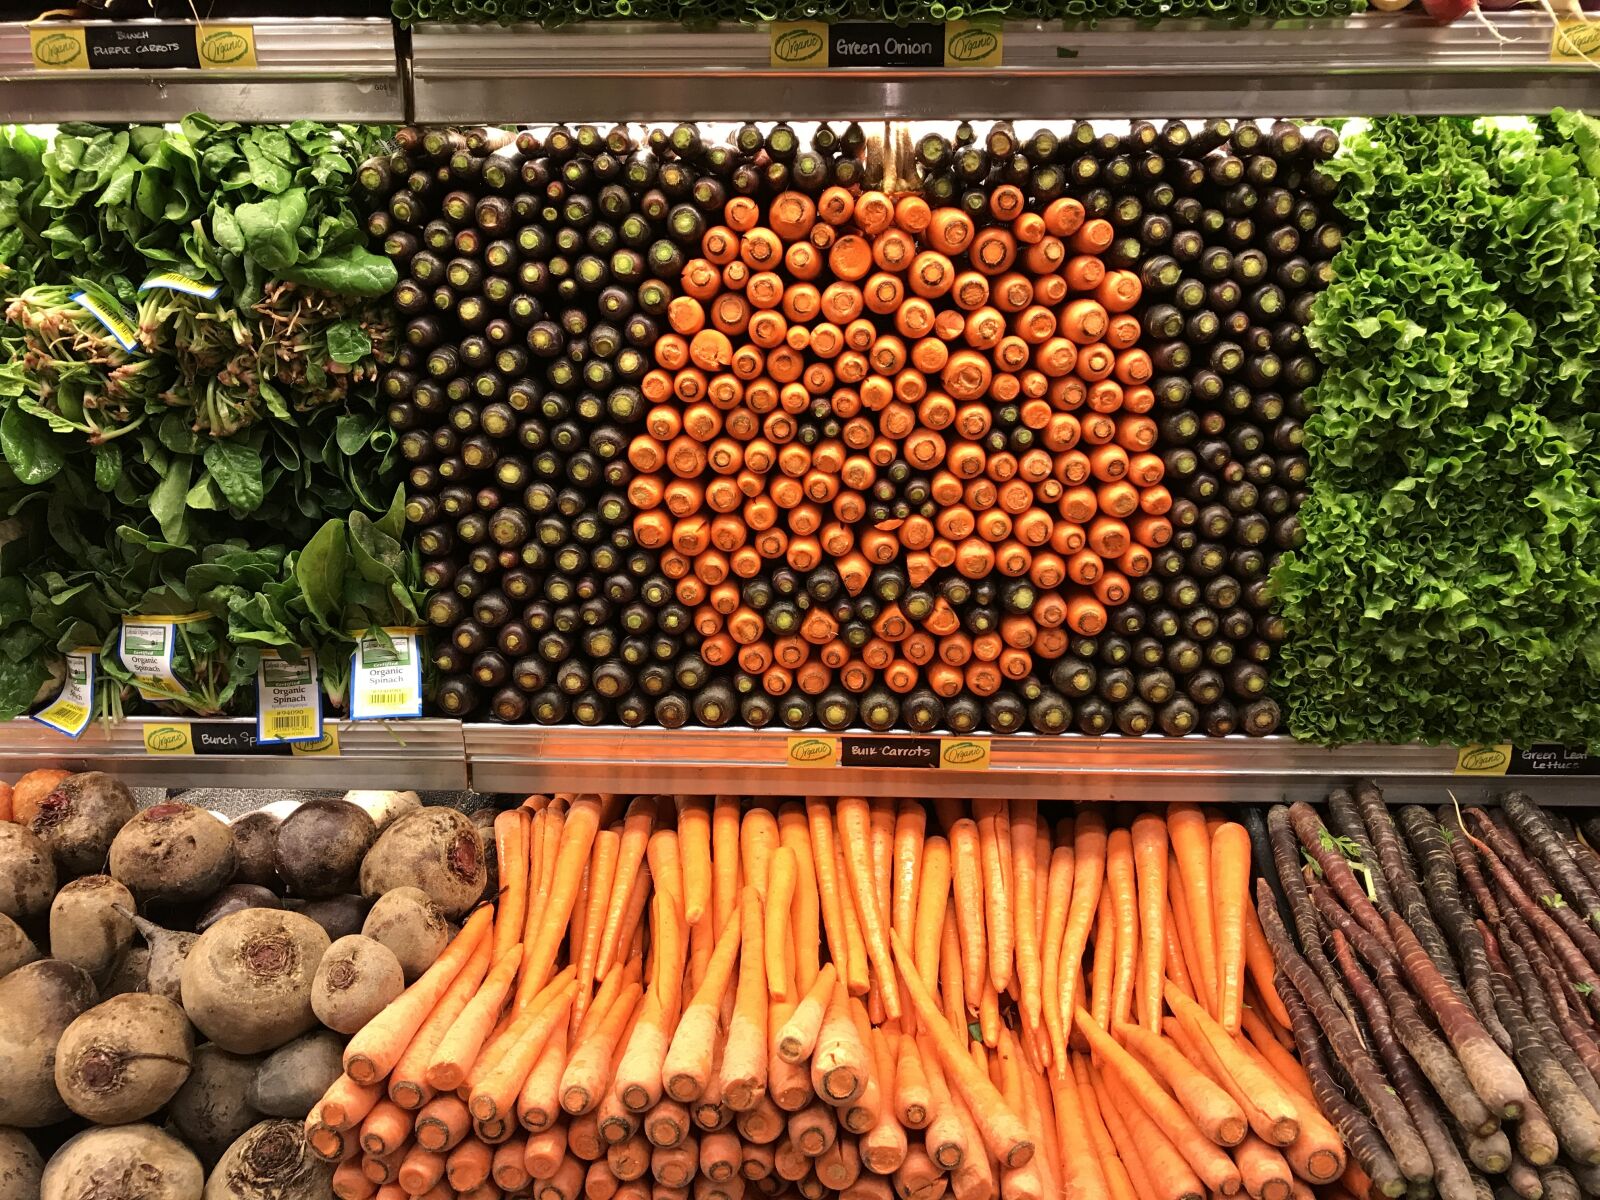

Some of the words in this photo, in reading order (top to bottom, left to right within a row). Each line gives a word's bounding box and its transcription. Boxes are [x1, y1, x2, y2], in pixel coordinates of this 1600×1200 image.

[41, 41, 76, 59] Organic
[207, 38, 245, 60] Organic
[780, 36, 818, 60] Organic
[836, 38, 881, 55] Green
[884, 37, 933, 55] Onion
[954, 36, 994, 60] Organic
[131, 656, 158, 665] Organic
[134, 664, 161, 673] Spinach
[369, 667, 404, 678] Organic
[369, 676, 404, 685] Spinach
[272, 686, 306, 697] Organic
[273, 695, 306, 705] Spinach
[153, 734, 182, 749] Organic
[201, 733, 238, 745] Bunch
[795, 743, 828, 759] Organic
[881, 745, 931, 757] Carrots
[949, 747, 981, 762] Organic
[1521, 750, 1557, 760] Green
[1466, 752, 1502, 769] Organic
